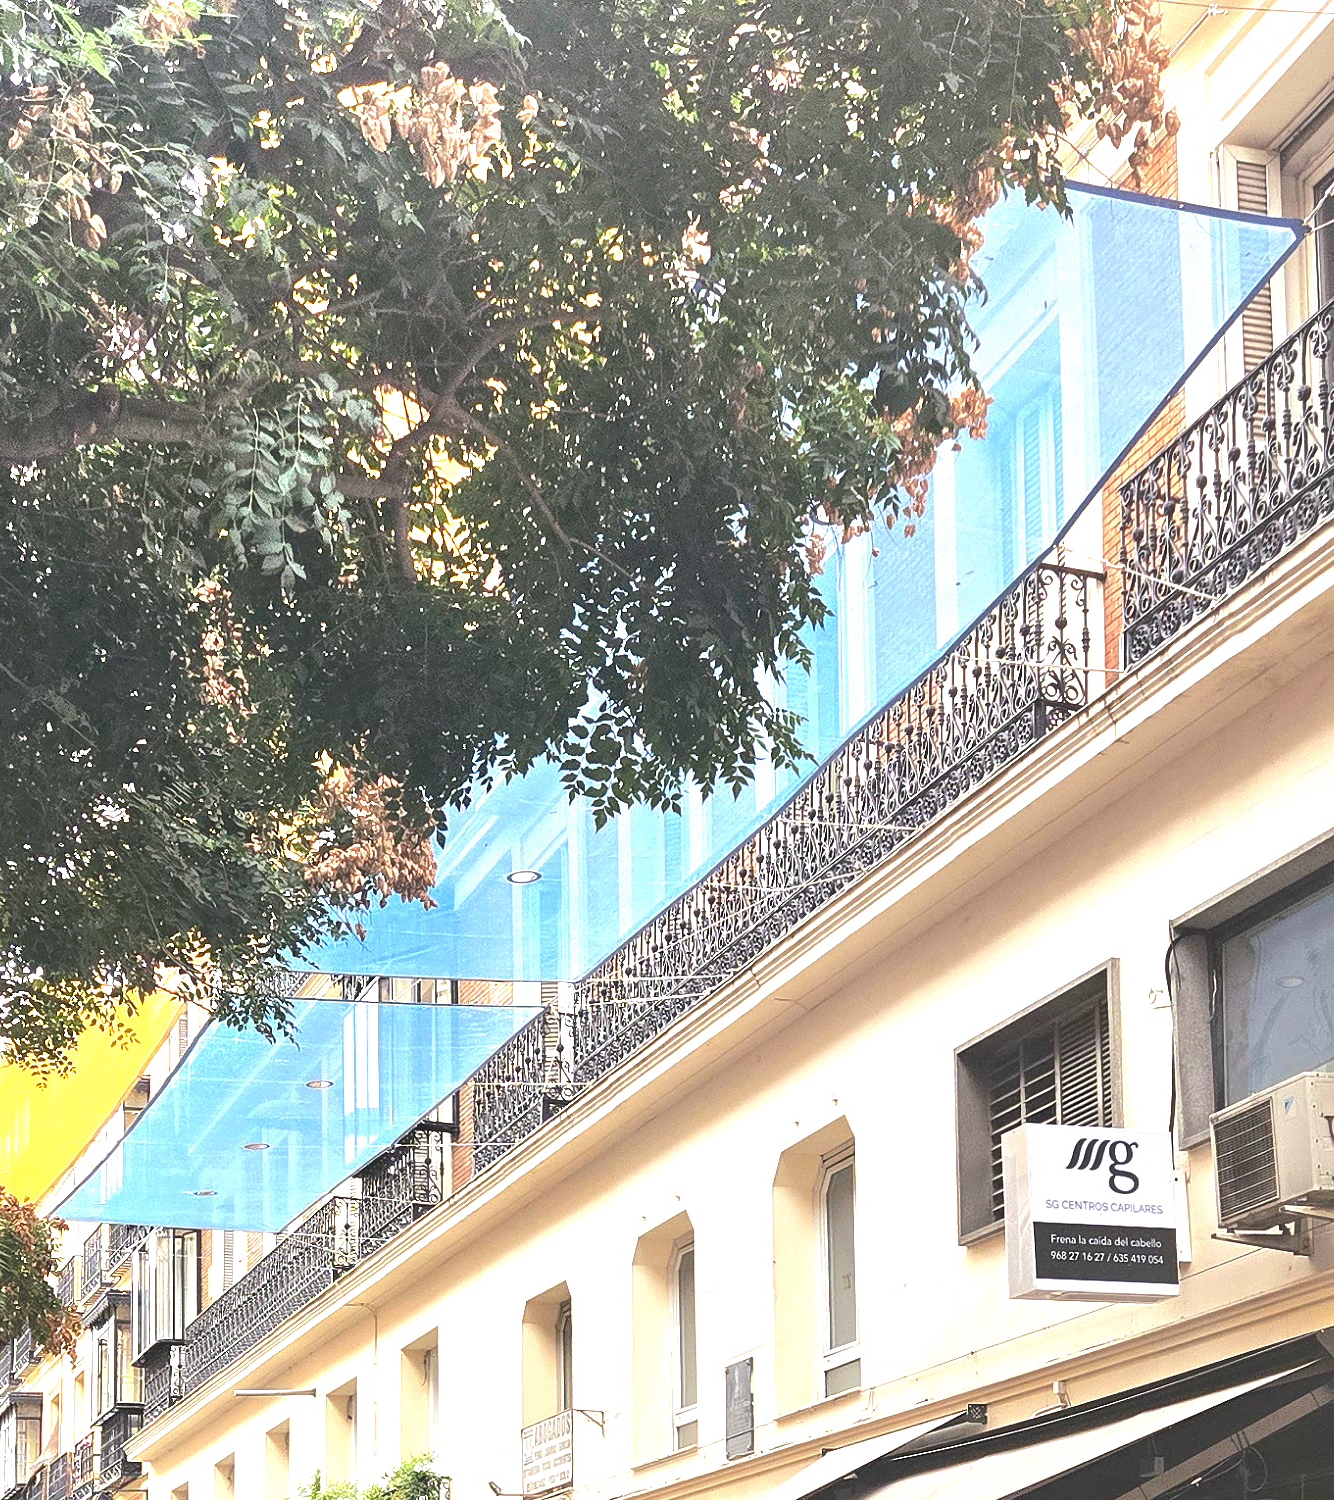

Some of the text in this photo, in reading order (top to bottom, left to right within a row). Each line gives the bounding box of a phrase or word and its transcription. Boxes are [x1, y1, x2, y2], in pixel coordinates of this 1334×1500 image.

[1045, 1199, 1164, 1215] SG CENTROS CAPILARES
[1050, 1234, 1077, 1245] Frena
[1078, 1235, 1087, 1245] la
[1114, 1236, 1129, 1247] del
[1130, 1238, 1162, 1248] cabello
[1050, 1251, 1067, 1261] 968
[1069, 1251, 1080, 1261] 27
[1082, 1252, 1093, 1262] 16
[1094, 1252, 1105, 1262] 27
[1113, 1253, 1129, 1263] 635
[1131, 1254, 1146, 1264] 419
[1148, 1255, 1164, 1265] 054
